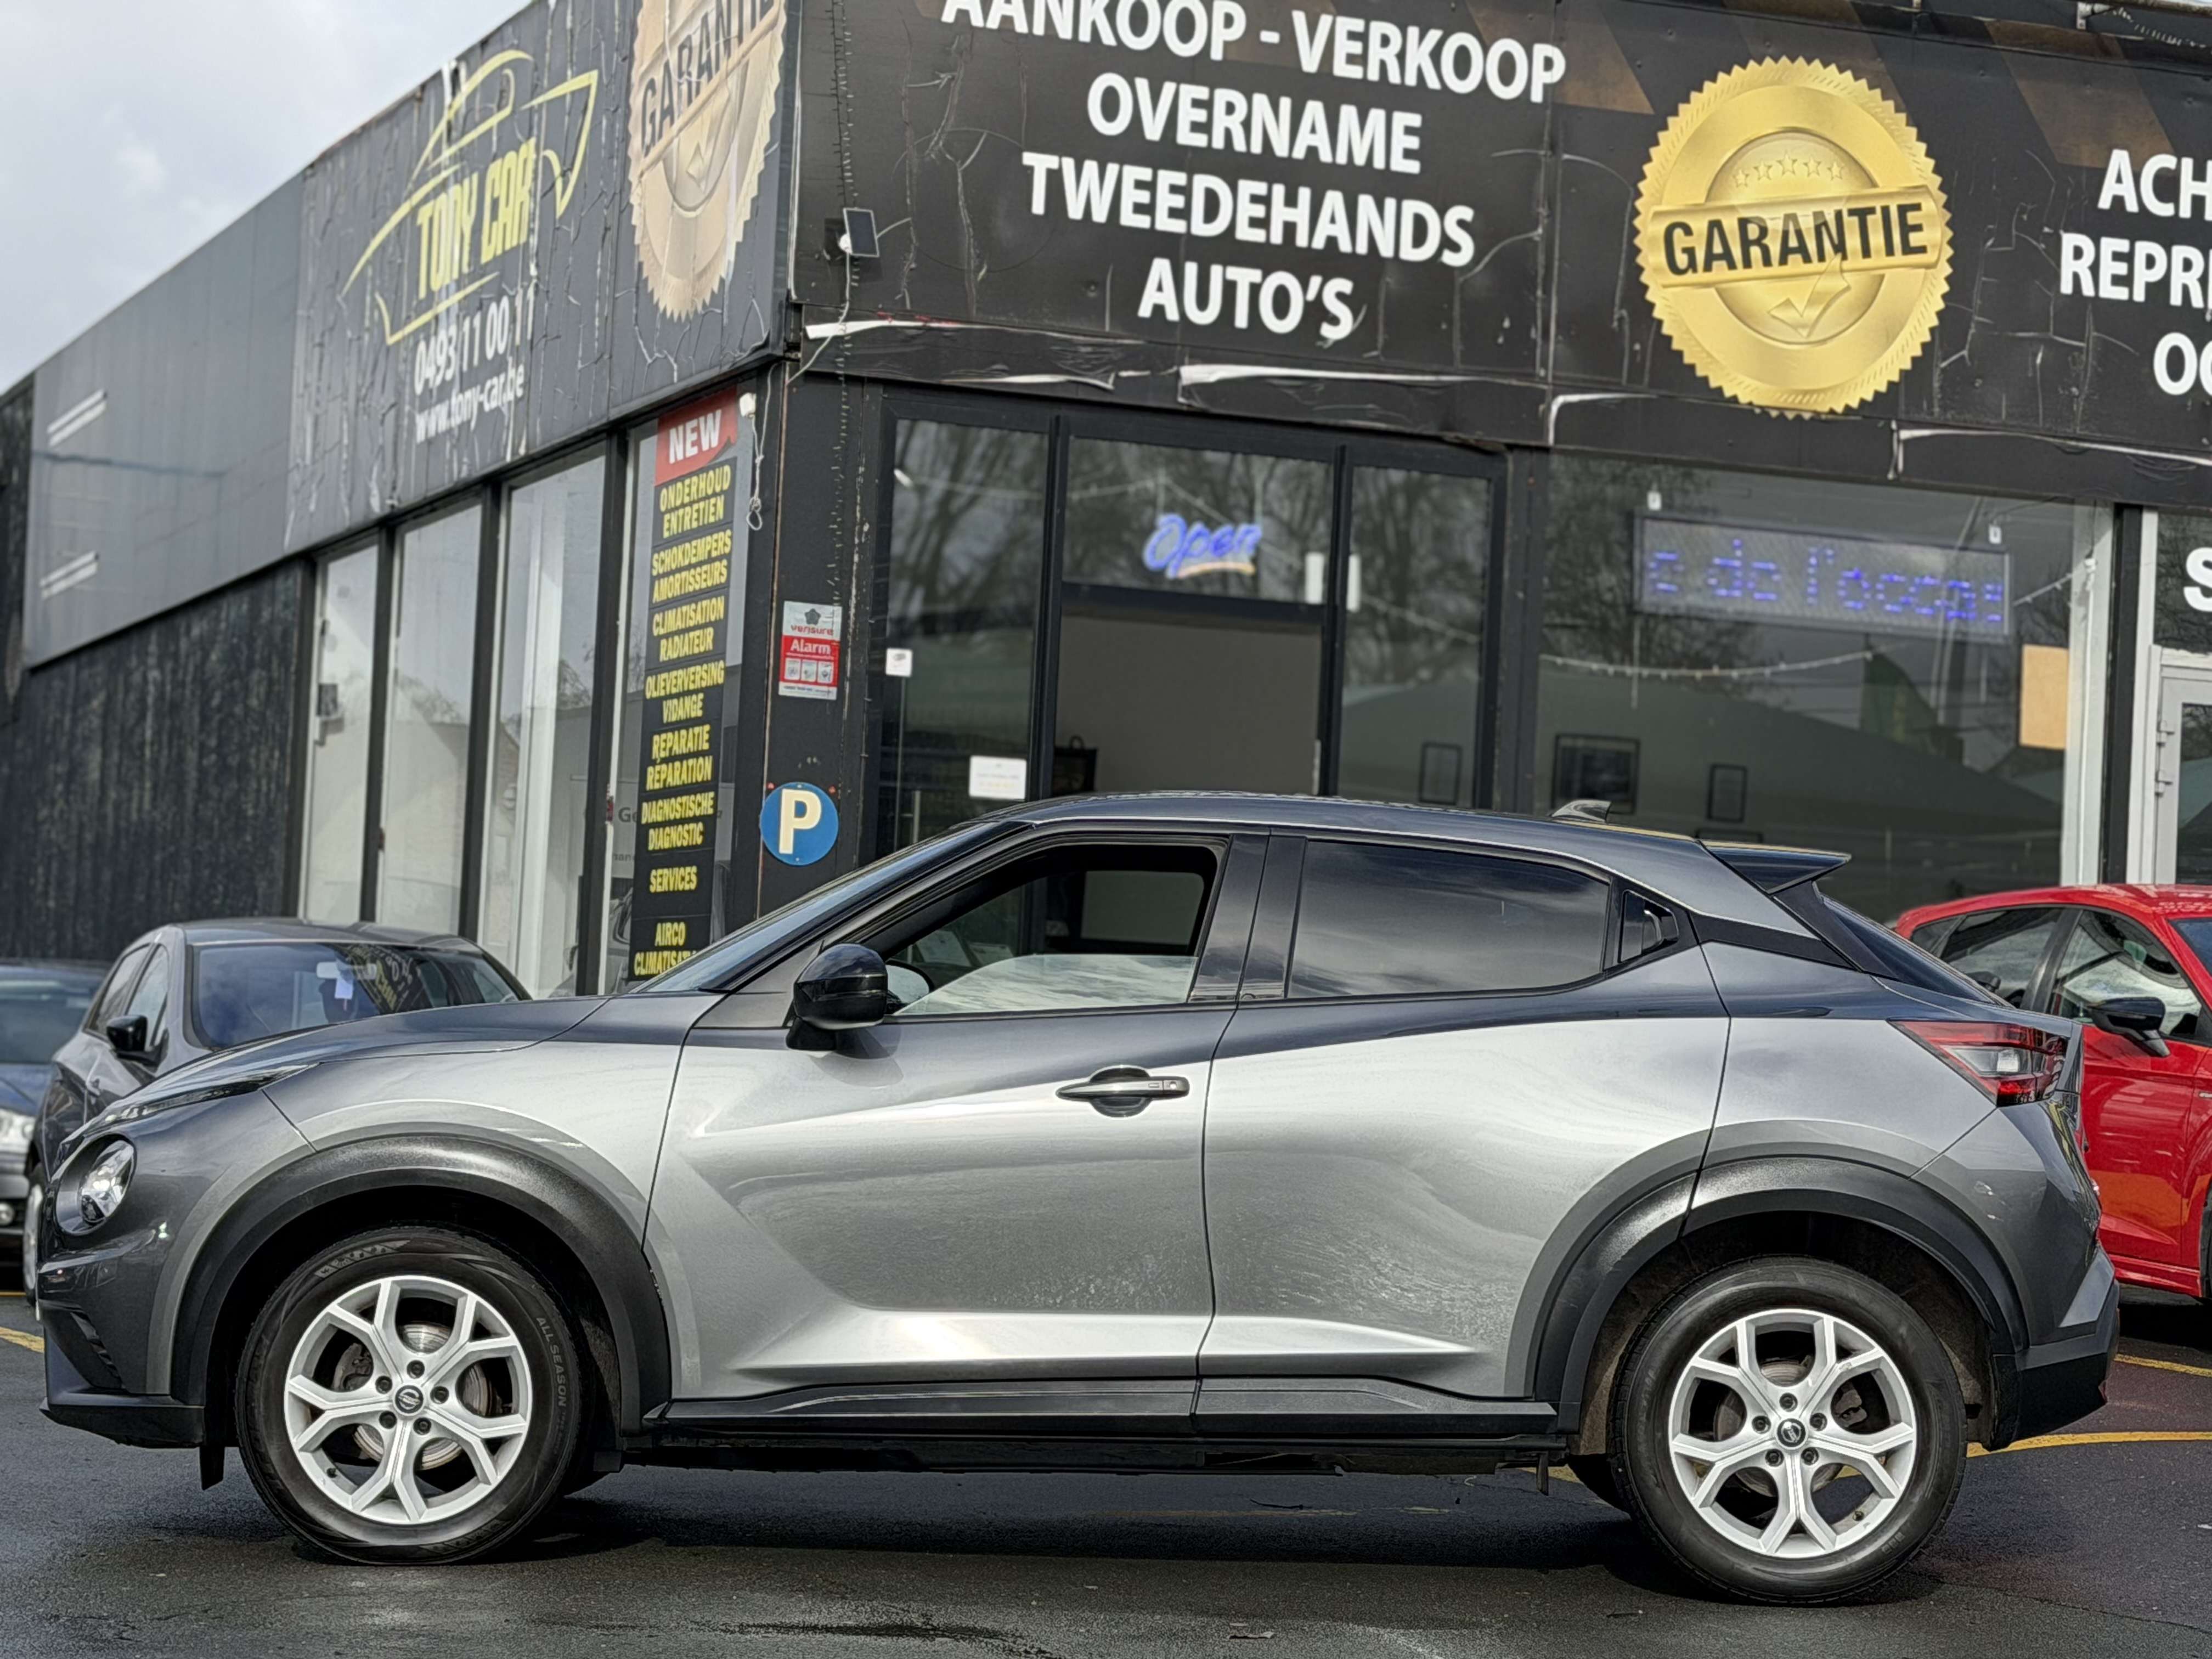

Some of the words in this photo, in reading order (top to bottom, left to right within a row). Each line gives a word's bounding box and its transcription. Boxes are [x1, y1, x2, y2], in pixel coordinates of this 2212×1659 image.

[641, 0, 776, 157] GARAN
[1291, 10, 1566, 104] VERKOOP
[1087, 72, 1423, 174] OVERNAME
[417, 171, 478, 300] TONY
[481, 136, 536, 264] CAR
[1022, 151, 1476, 268] TWEEDEHANDS
[1663, 202, 1927, 275] GARANTIE
[1138, 257, 1355, 340] AUTO'S
[486, 295, 509, 360] 00
[415, 357, 524, 443] www.tony-car.be
[669, 409, 721, 464] NEW
[660, 465, 731, 512] ONDERHOUD
[663, 494, 724, 539] ENTRETIEN
[652, 529, 731, 576] SCHOKDEMPERS
[1143, 513, 1261, 579] Open
[652, 559, 727, 603] AMORTISSEURS
[652, 595, 725, 636] CLIMATISATION
[791, 624, 834, 635] verisure
[660, 627, 714, 662] RADIATEUR
[790, 639, 831, 654] Alarm
[645, 660, 725, 699] OLIEVERVERSING
[663, 693, 704, 724] VIDANGE
[652, 724, 710, 759] REPARATIE
[641, 791, 715, 824] DIAGNOSTISCHE
[779, 789, 822, 854] P
[648, 822, 704, 851] DIAGNOSTIC
[650, 865, 697, 893] SERVICES
[654, 922, 686, 946] AIRCO
[634, 950, 697, 976] CLIMATIS
